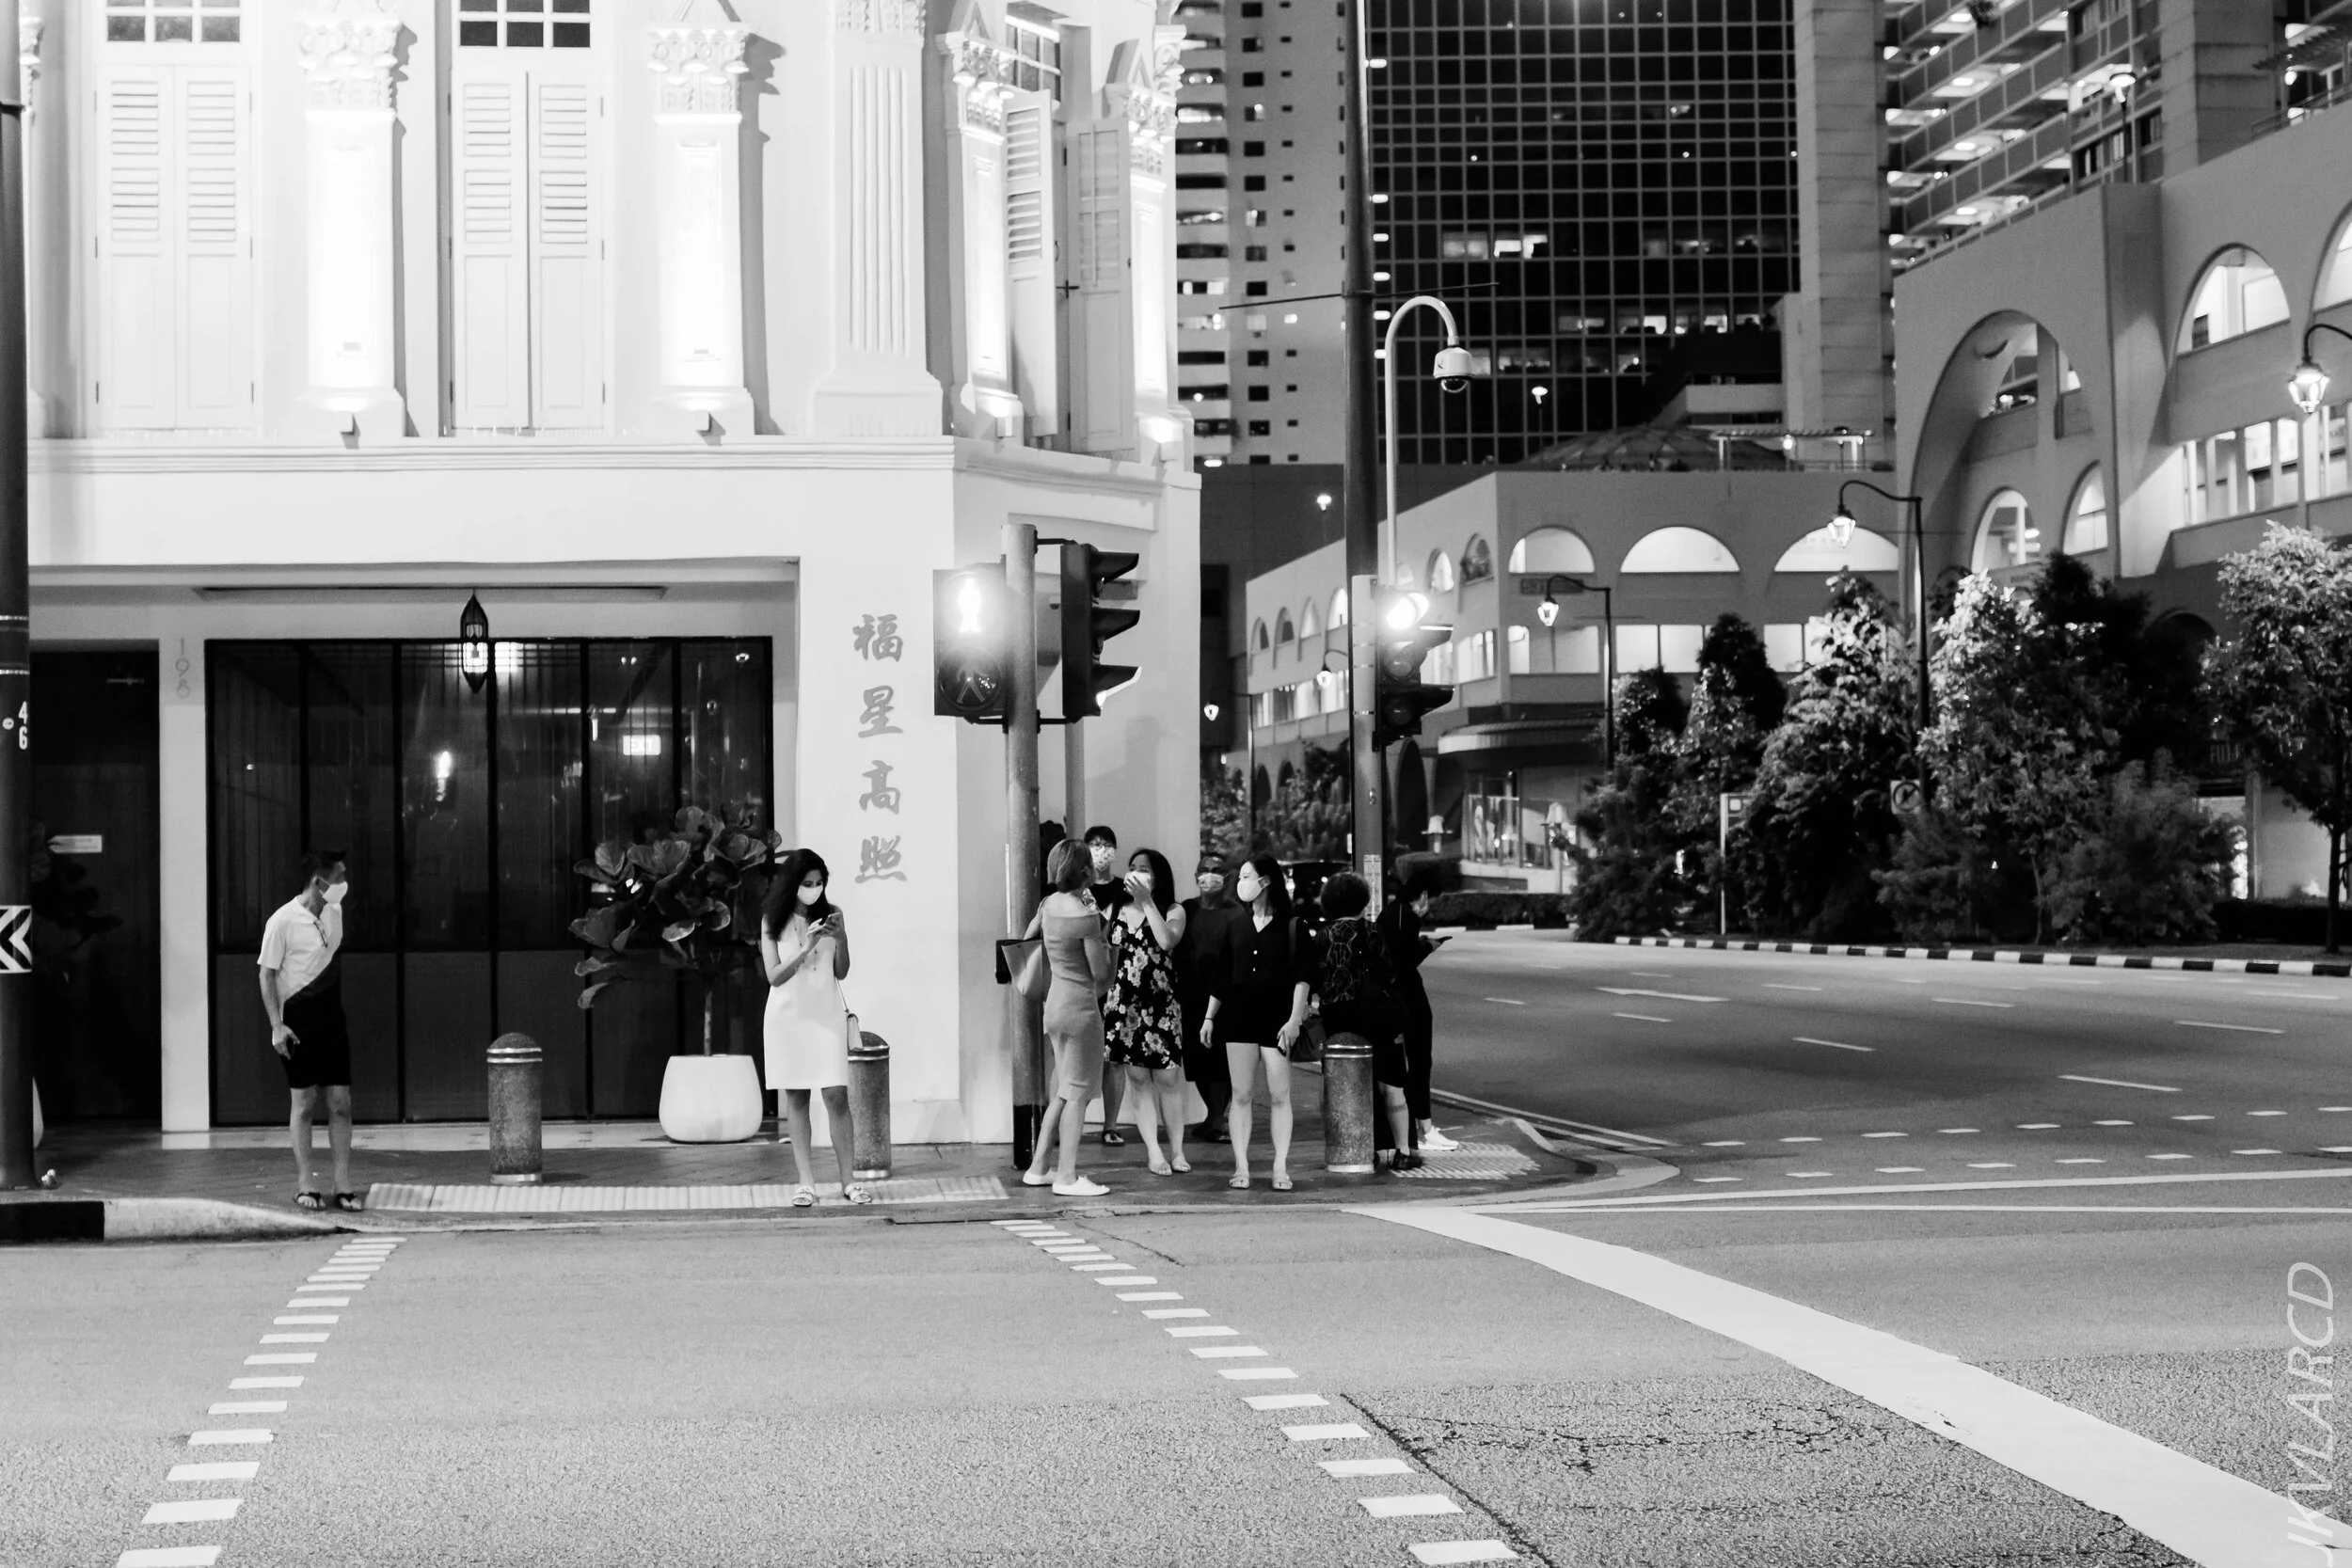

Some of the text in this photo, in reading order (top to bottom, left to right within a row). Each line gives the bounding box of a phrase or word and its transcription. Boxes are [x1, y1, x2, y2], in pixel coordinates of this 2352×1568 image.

[18, 700, 28, 750] 46
[851, 613, 907, 884] 福星高照
